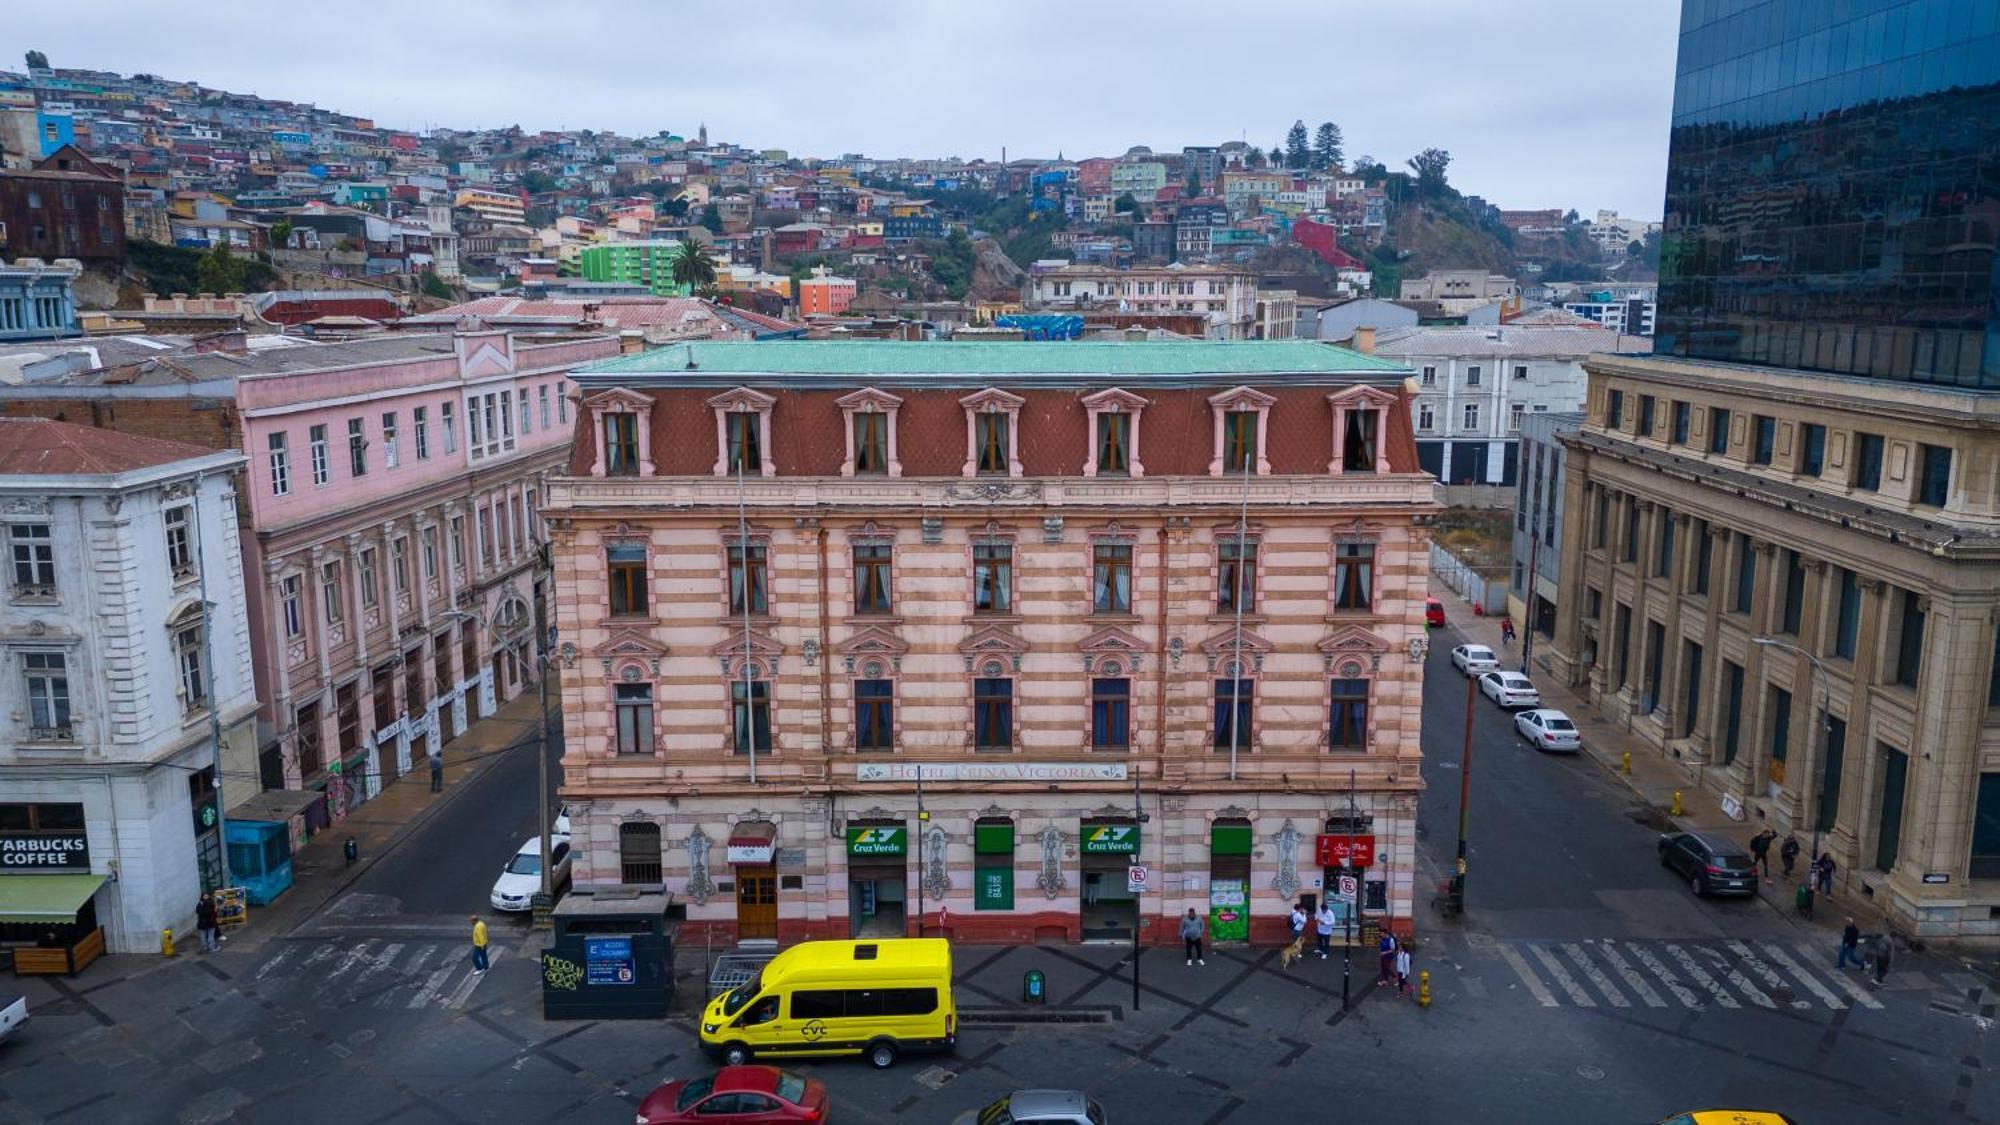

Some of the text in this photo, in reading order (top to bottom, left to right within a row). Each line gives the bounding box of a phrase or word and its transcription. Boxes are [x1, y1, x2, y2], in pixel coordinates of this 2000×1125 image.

[1016, 764, 1098, 779] VICTORIA
[0, 839, 84, 851] ARBUCKS
[854, 843, 900, 853] Cruz Verde
[1087, 841, 1134, 850] Cruz Verde
[3, 853, 68, 865] COFFEE
[801, 1026, 827, 1035] CVC
